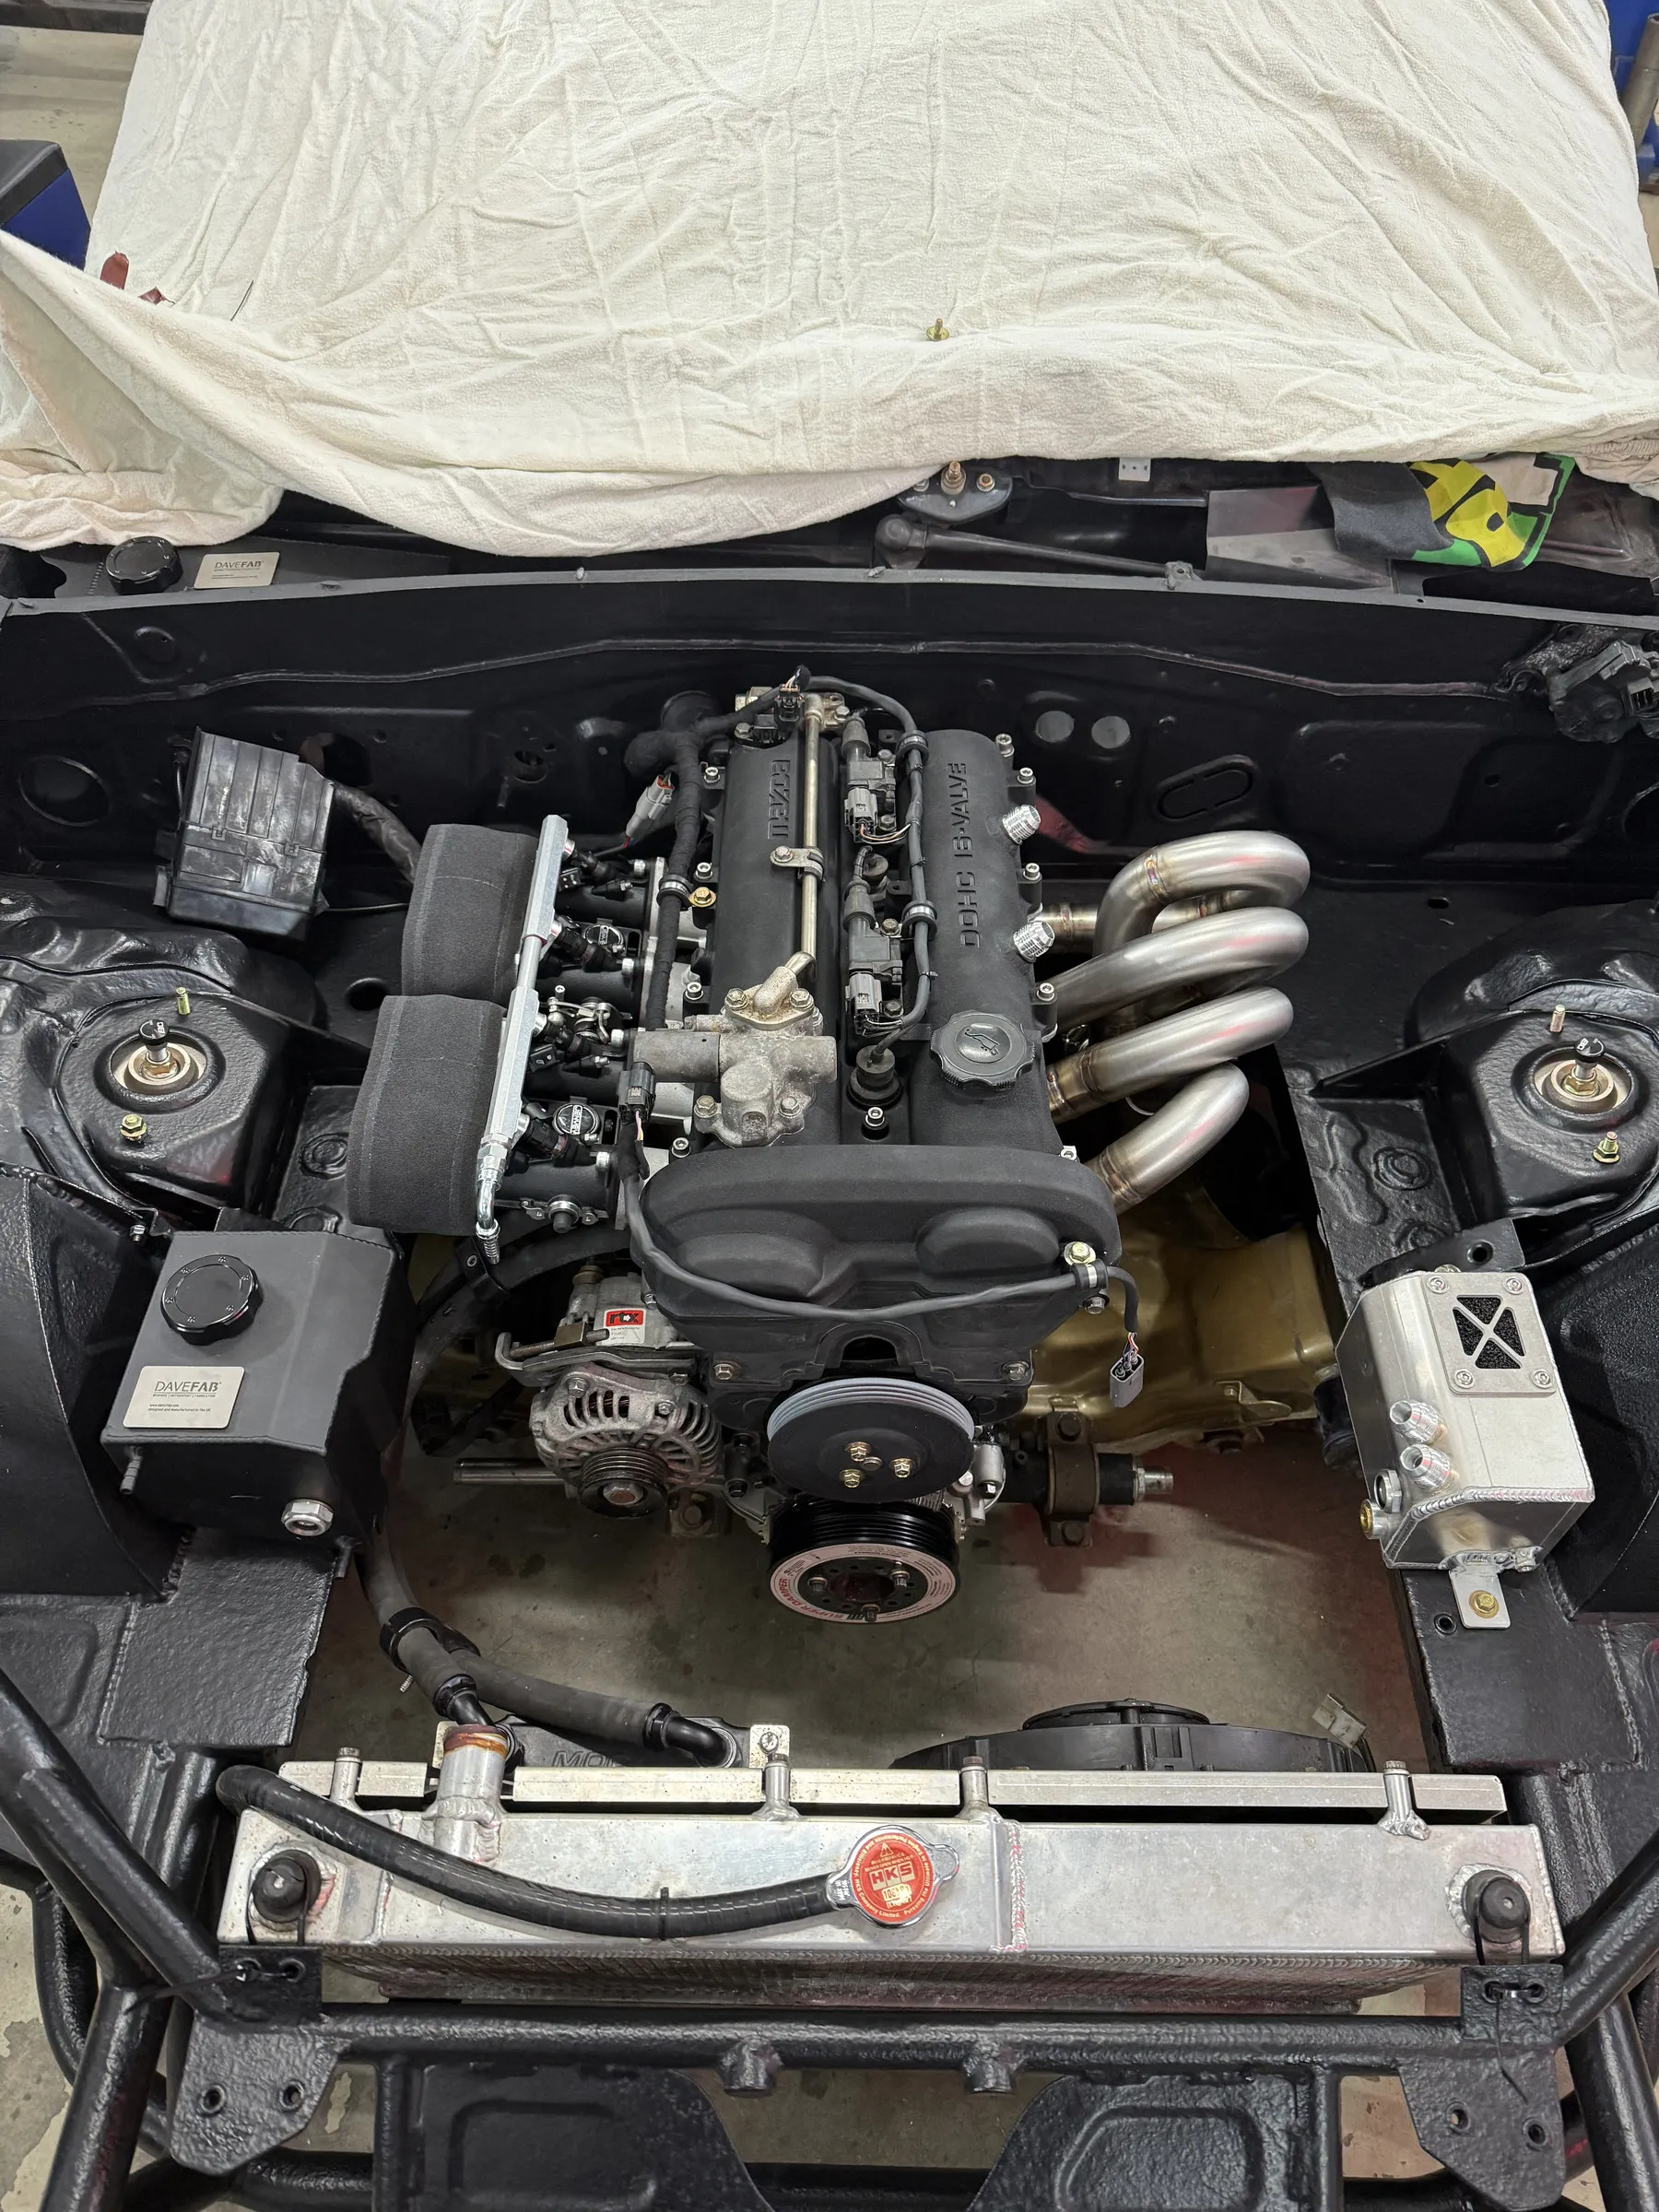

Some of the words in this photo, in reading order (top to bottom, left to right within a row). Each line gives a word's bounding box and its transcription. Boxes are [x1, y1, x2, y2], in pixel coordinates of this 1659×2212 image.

[215, 560, 263, 569] DAVEFAB
[955, 871, 981, 948] DOHC
[154, 1381, 219, 1392] DAVEFAB
[779, 1578, 803, 1606] DAMPER
[870, 1861, 913, 1886] HKS
[858, 1891, 879, 1914] Company
